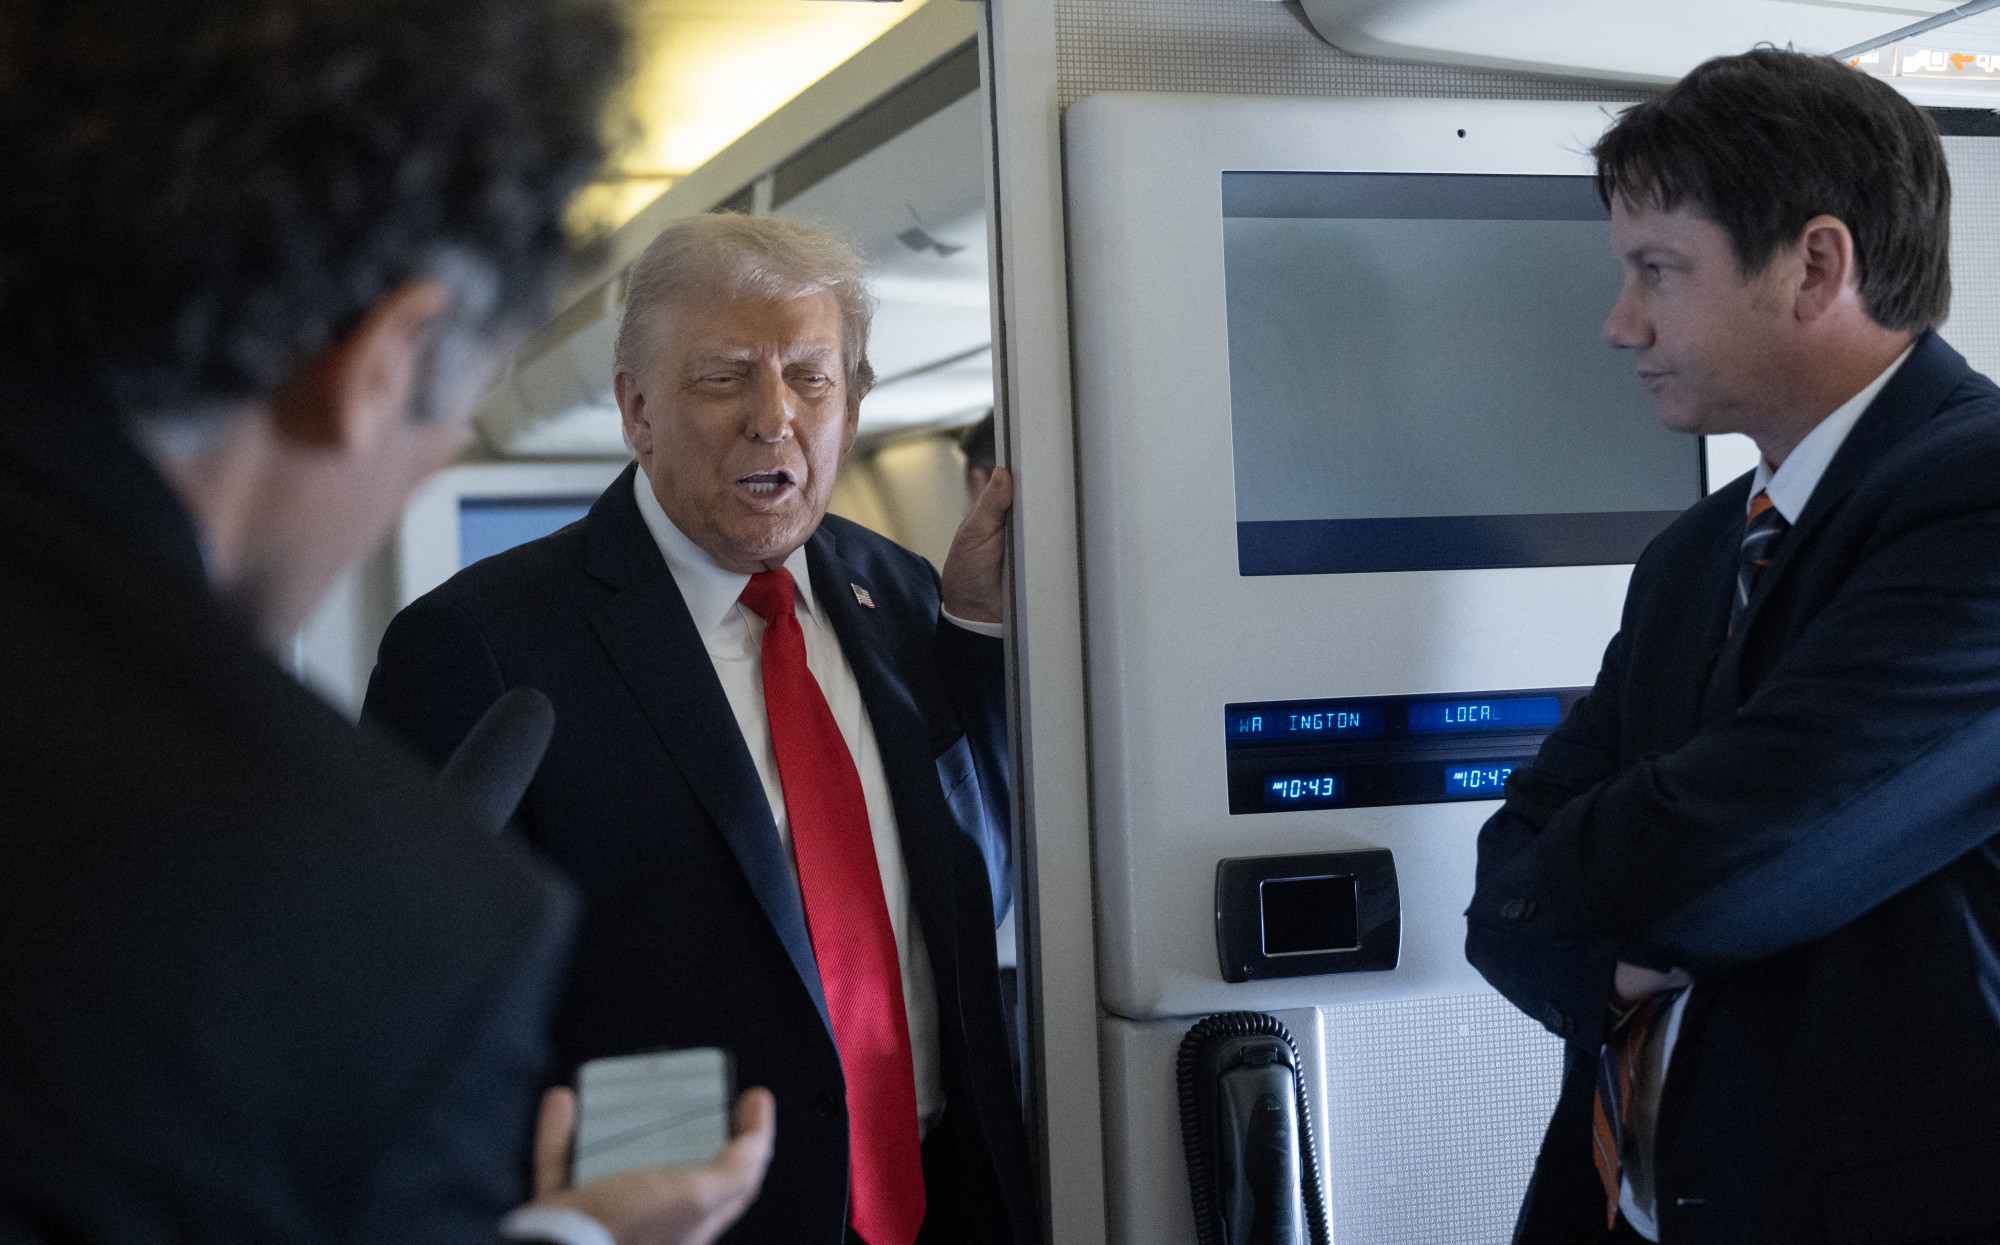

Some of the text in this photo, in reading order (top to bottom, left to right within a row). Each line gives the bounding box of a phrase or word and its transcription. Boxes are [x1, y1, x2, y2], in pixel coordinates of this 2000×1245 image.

[1239, 712, 1360, 732] WAINGTON
[1445, 705, 1502, 723] LOCAL
[1453, 772, 1464, 780] AM
[1272, 777, 1333, 798] AM 10:43
